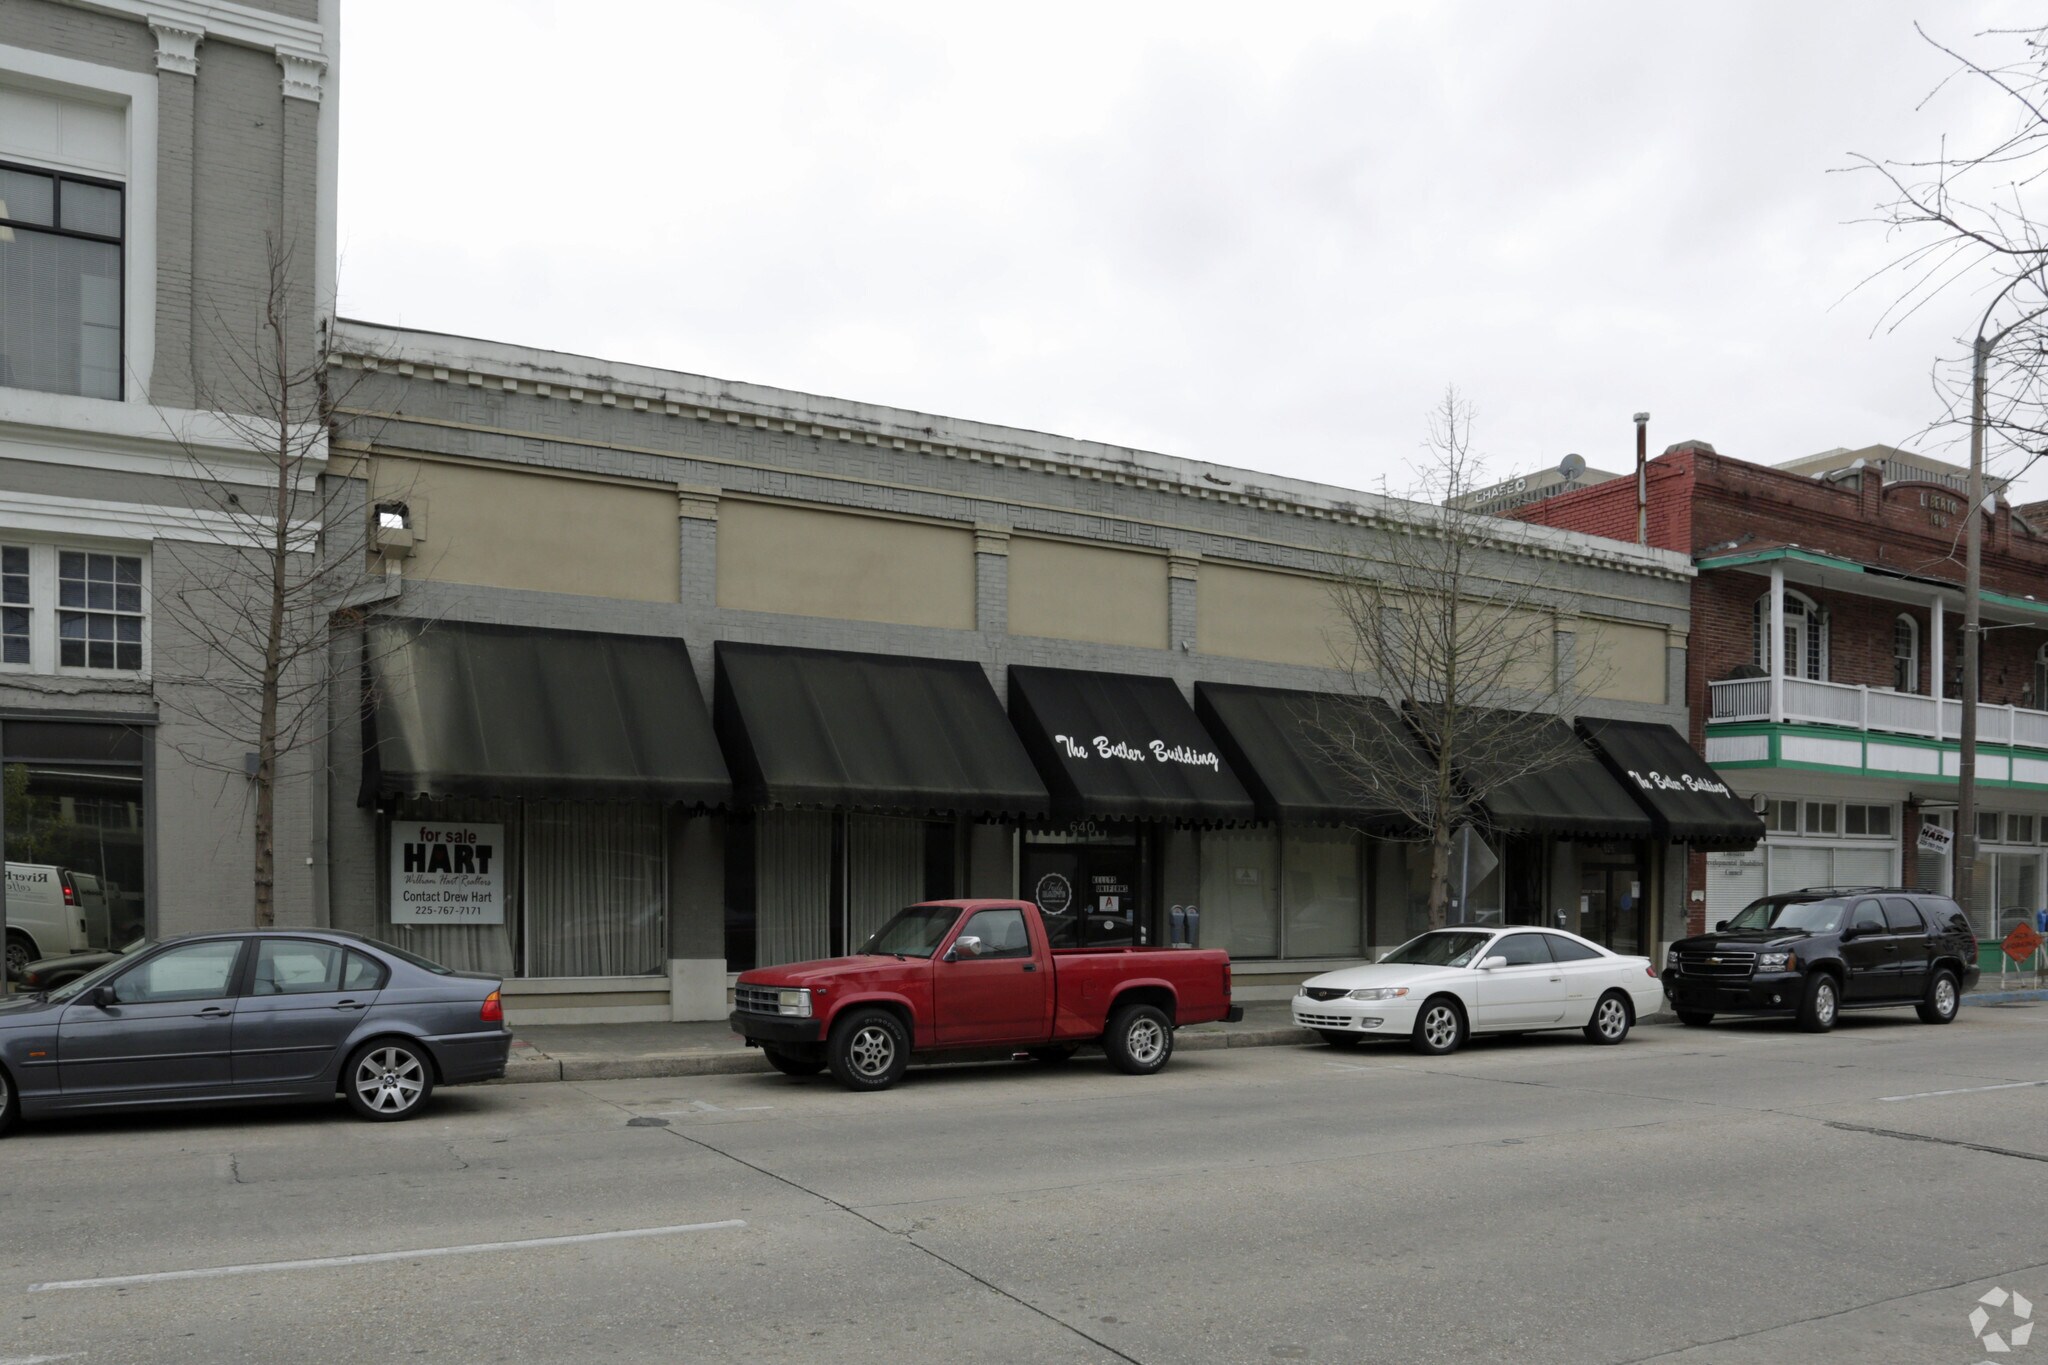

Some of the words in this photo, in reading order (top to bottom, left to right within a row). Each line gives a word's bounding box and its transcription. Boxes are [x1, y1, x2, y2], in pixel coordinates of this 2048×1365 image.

[1475, 482, 1514, 503] CHASE
[1054, 734, 1088, 759] The
[1092, 735, 1145, 762] Butler
[1149, 739, 1219, 773] Building
[1627, 770, 1653, 790] The
[1649, 771, 1685, 790] Butler
[1681, 774, 1731, 799] Building
[419, 826, 441, 842] for
[445, 829, 477, 844] sale
[1070, 821, 1096, 833] 640
[1921, 828, 1950, 844] HART
[404, 843, 492, 874] HART
[404, 874, 436, 885] William
[439, 874, 459, 885] Hart
[403, 890, 440, 902] Contact
[443, 891, 468, 902] Drew
[471, 892, 492, 902] Hart
[415, 906, 481, 915] 225-767-7171
